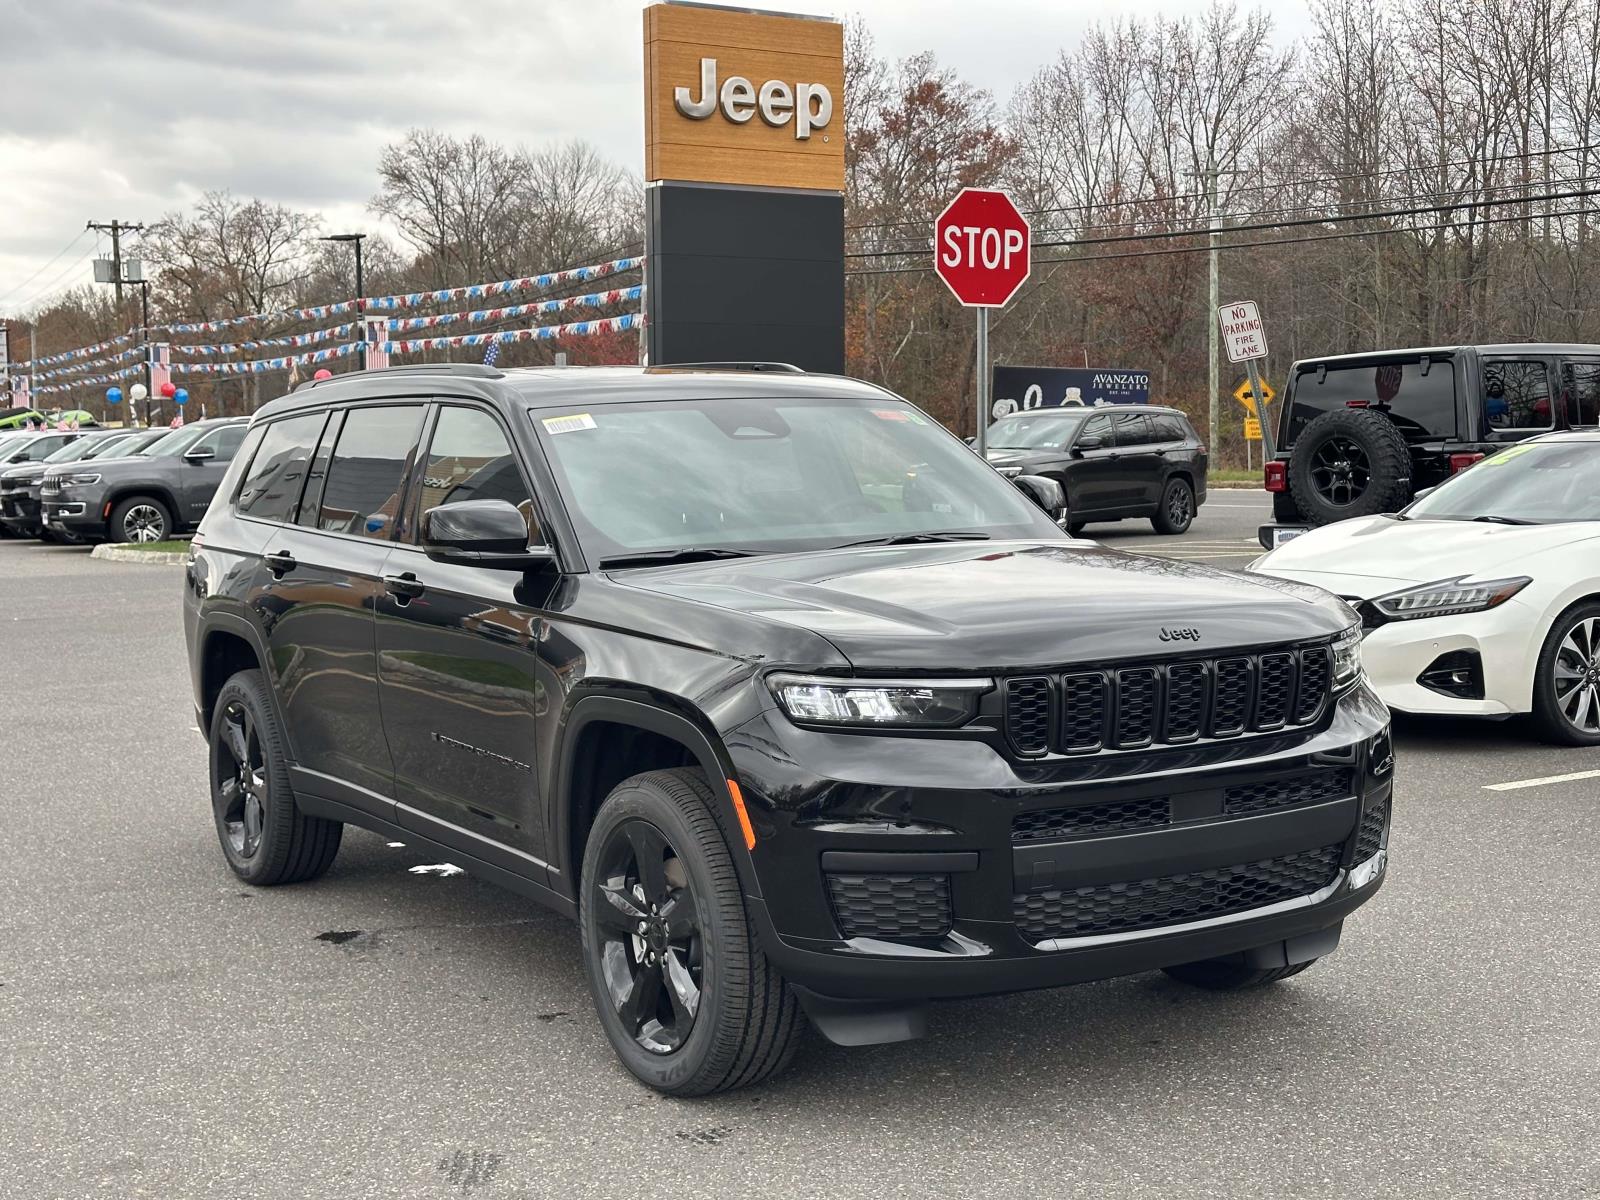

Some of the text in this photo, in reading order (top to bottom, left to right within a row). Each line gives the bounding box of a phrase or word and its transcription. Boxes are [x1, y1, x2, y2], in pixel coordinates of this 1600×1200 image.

[674, 58, 833, 140] Jeep
[942, 225, 1024, 270] STOP
[1231, 307, 1246, 319] NO
[1224, 319, 1259, 335] PARKING
[1235, 335, 1254, 345] FIRE
[1235, 345, 1259, 356] LANE
[1092, 374, 1148, 384] AVANZATO
[1092, 382, 1148, 390] JEWELERS
[1159, 627, 1201, 642] Jeep
